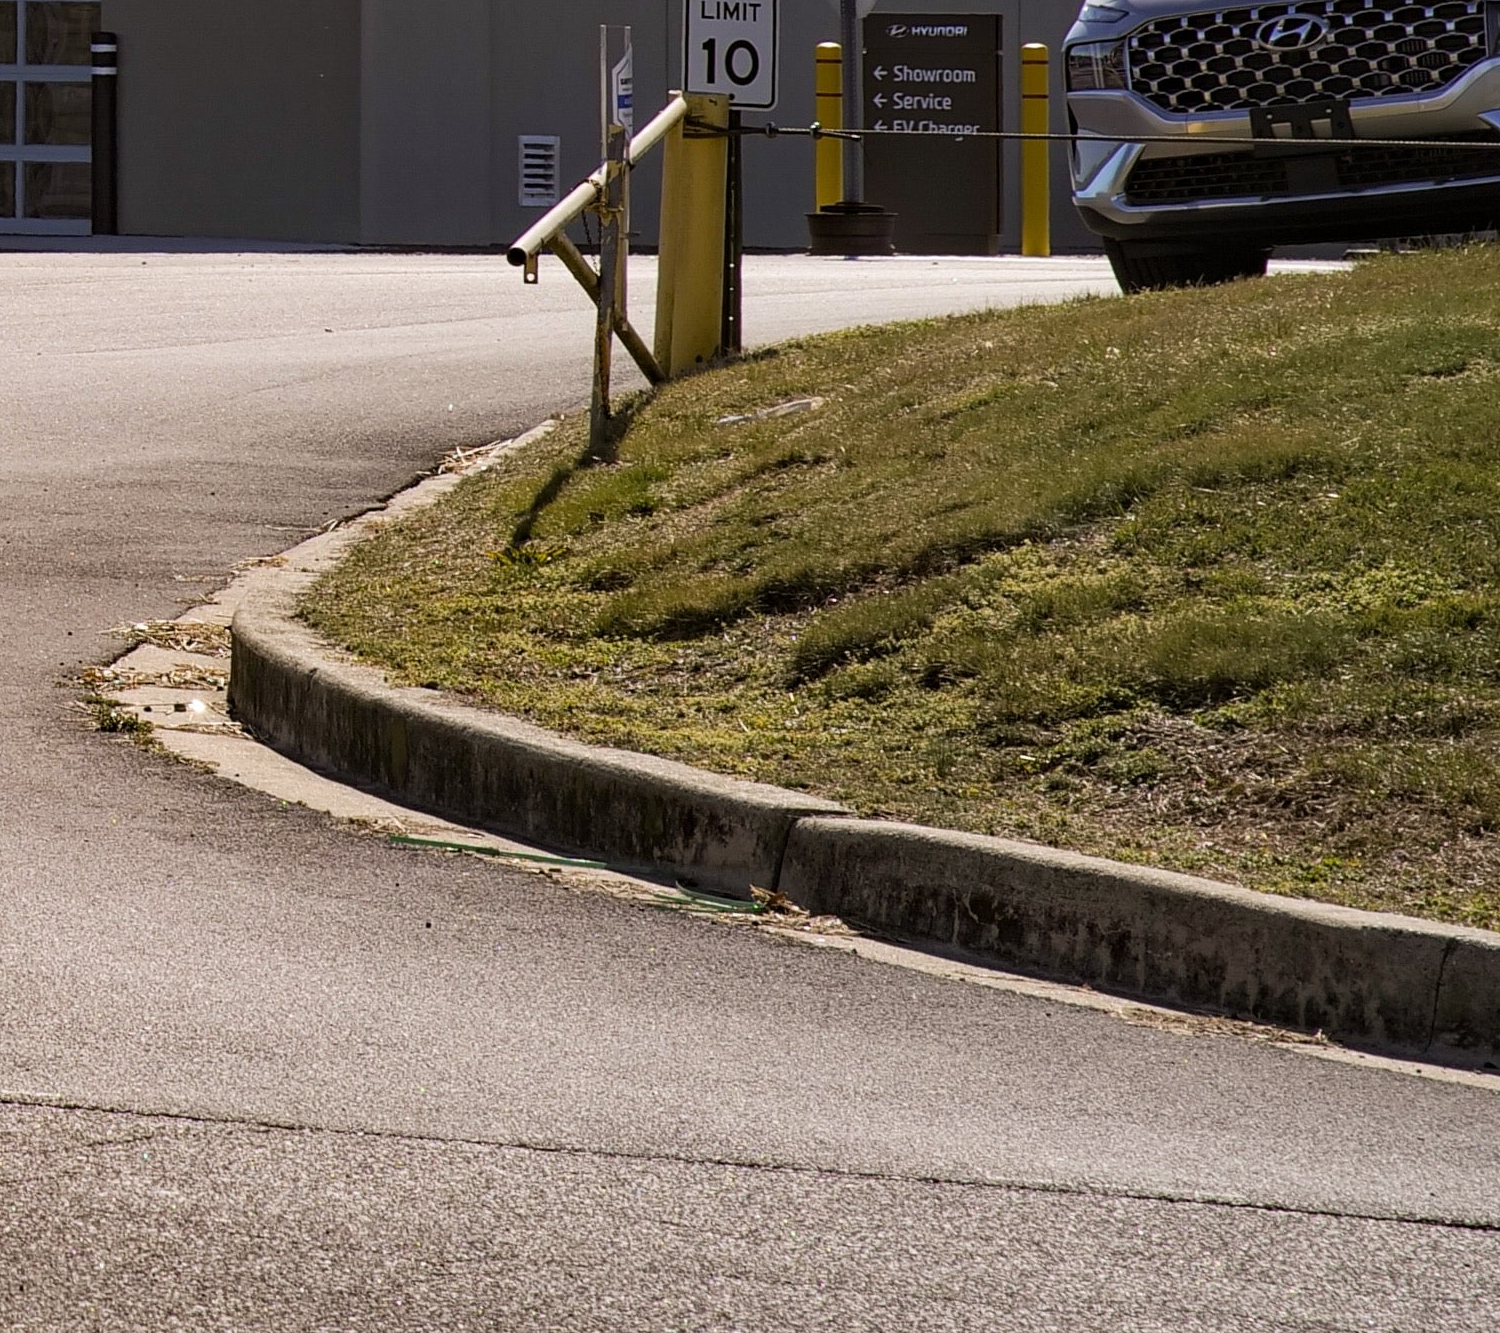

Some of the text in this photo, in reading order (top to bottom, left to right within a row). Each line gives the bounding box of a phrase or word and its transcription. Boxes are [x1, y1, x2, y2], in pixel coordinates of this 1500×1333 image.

[701, 0, 762, 22] LIMIT
[911, 26, 968, 37] HYUNDAI
[702, 38, 760, 86] 10
[893, 65, 976, 82] Showroom
[892, 93, 952, 110] Service
[892, 120, 981, 141] EV Charger
